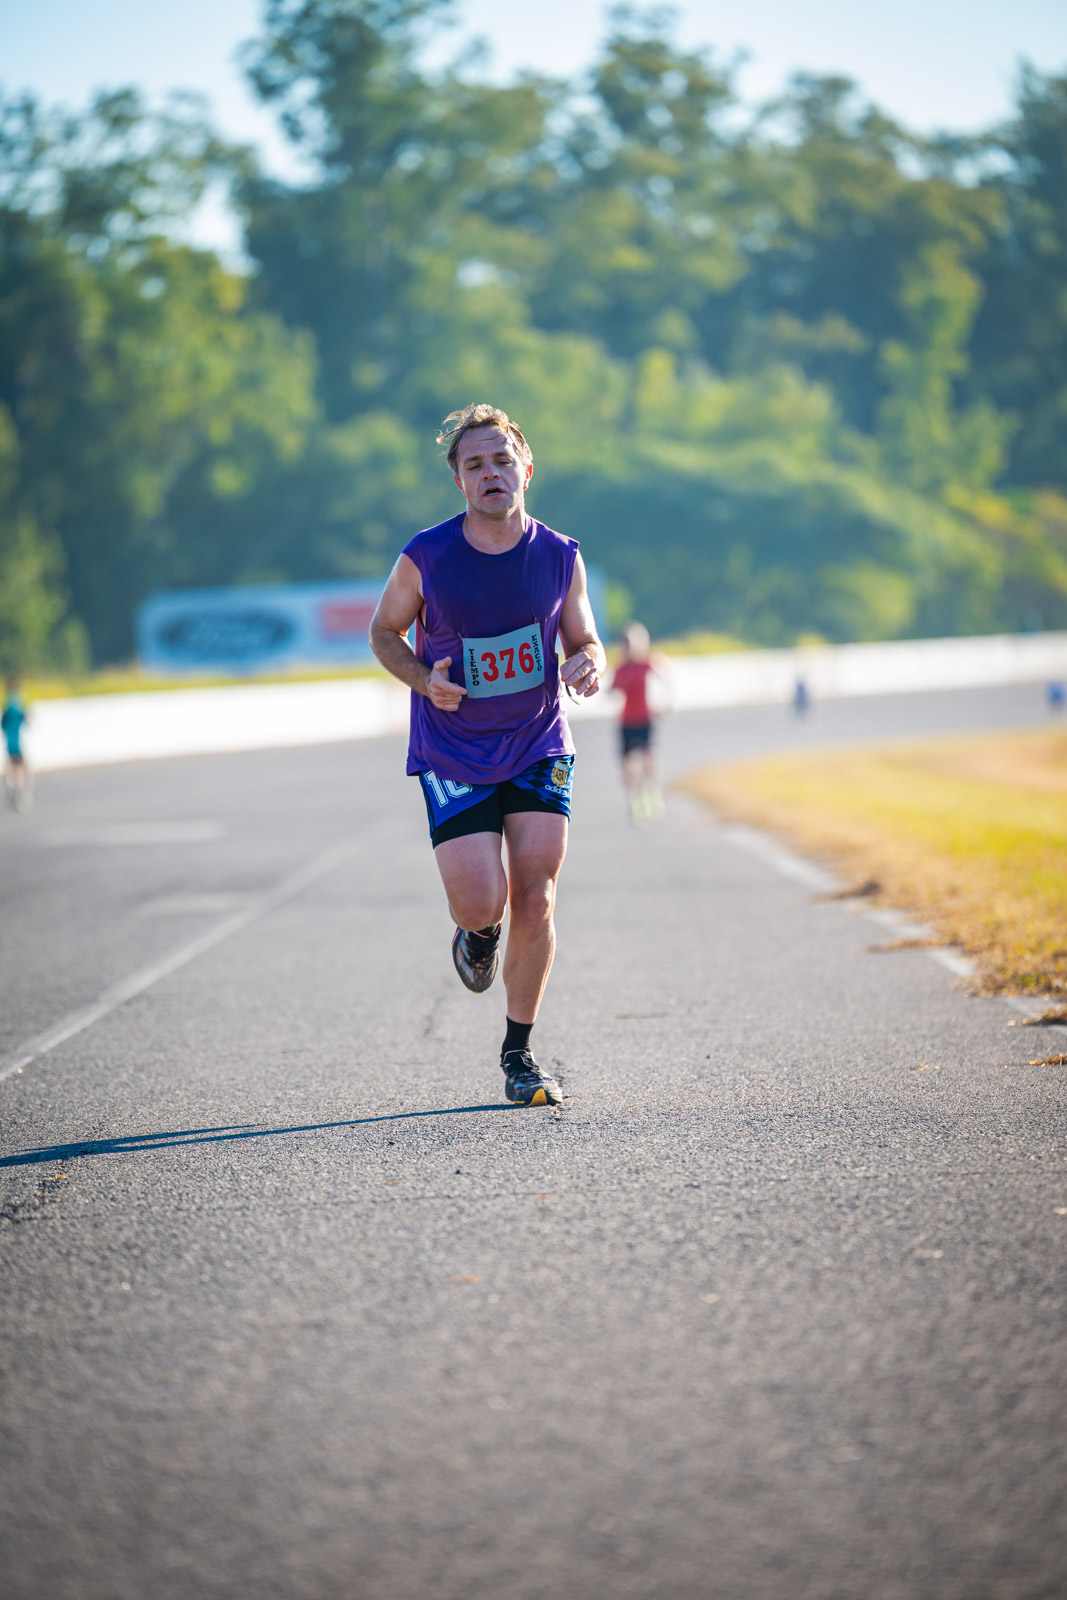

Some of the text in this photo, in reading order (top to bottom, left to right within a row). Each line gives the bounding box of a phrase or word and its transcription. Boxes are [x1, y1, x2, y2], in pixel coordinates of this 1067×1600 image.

[468, 648, 480, 686] TIEMPO
[481, 642, 535, 682] 376
[531, 634, 543, 672] EXACTO
